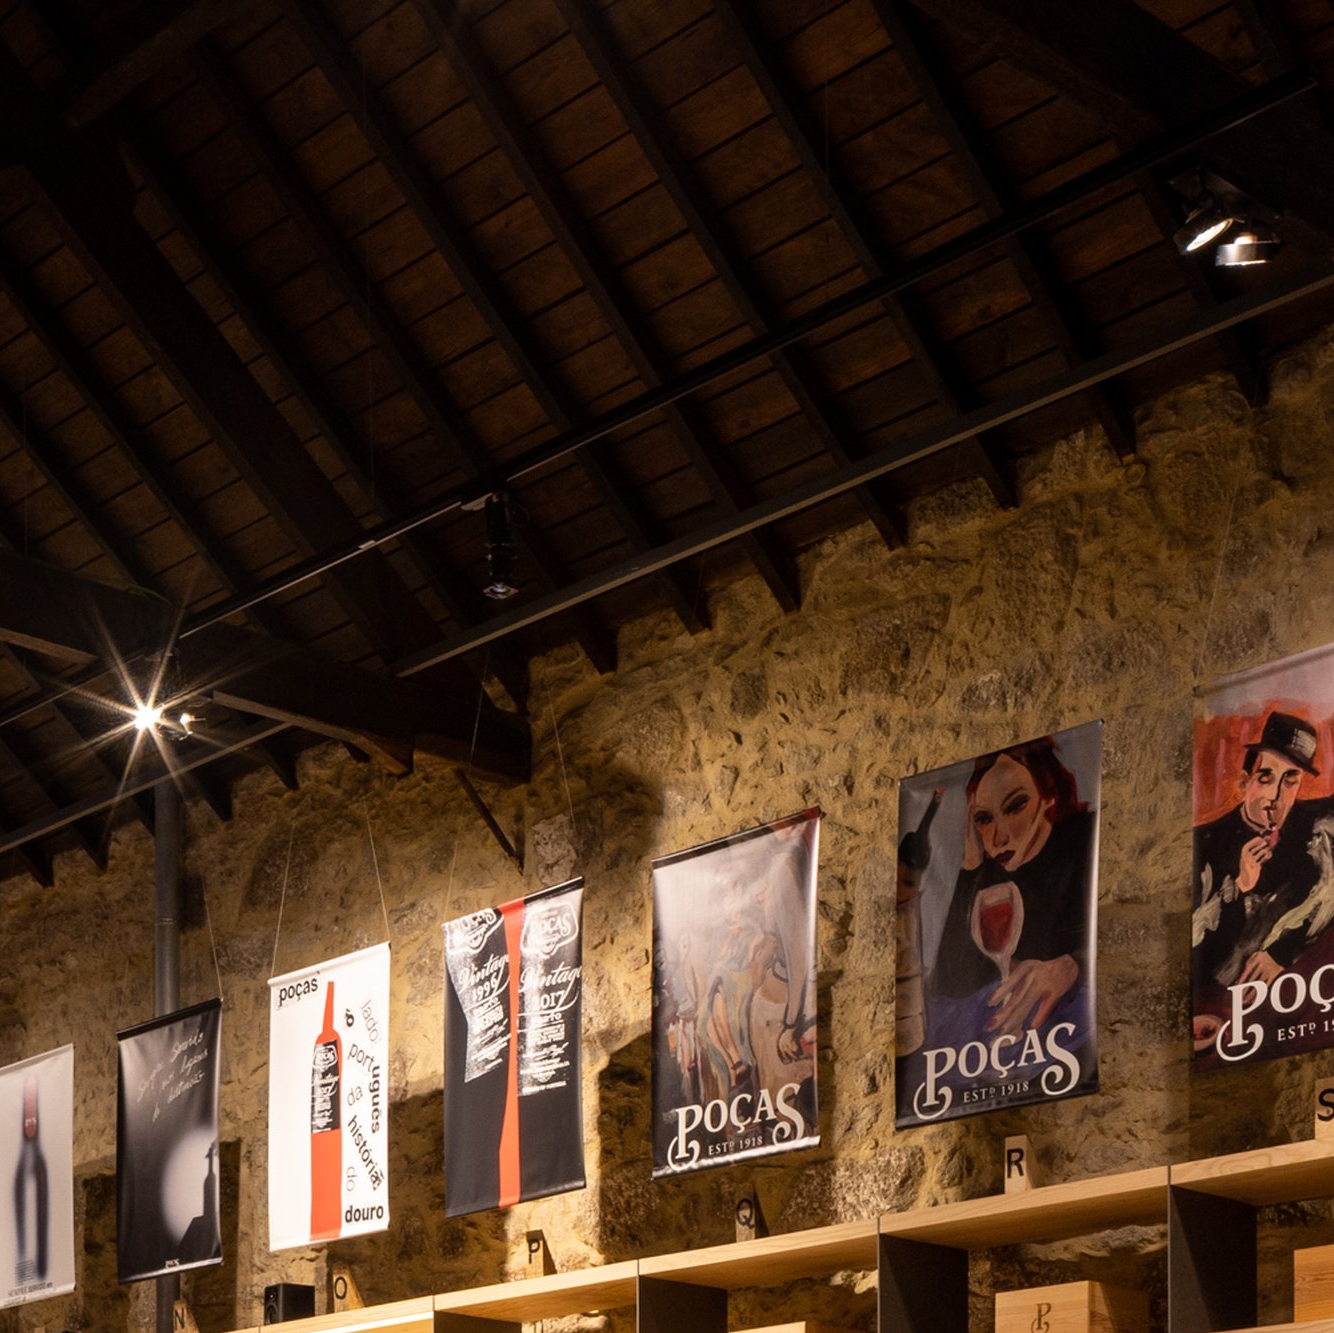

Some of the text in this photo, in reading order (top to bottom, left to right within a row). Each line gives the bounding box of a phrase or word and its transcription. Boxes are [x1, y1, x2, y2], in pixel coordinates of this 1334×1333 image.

[278, 977, 319, 1007] poças
[913, 1023, 1080, 1120] POÇAS
[1000, 1081, 1030, 1097] 1918
[667, 1082, 805, 1172] POÇAS
[739, 1135, 763, 1150] 1918
[1006, 1148, 1024, 1179] R
[344, 1204, 384, 1223] douro
[736, 1199, 755, 1230] Q
